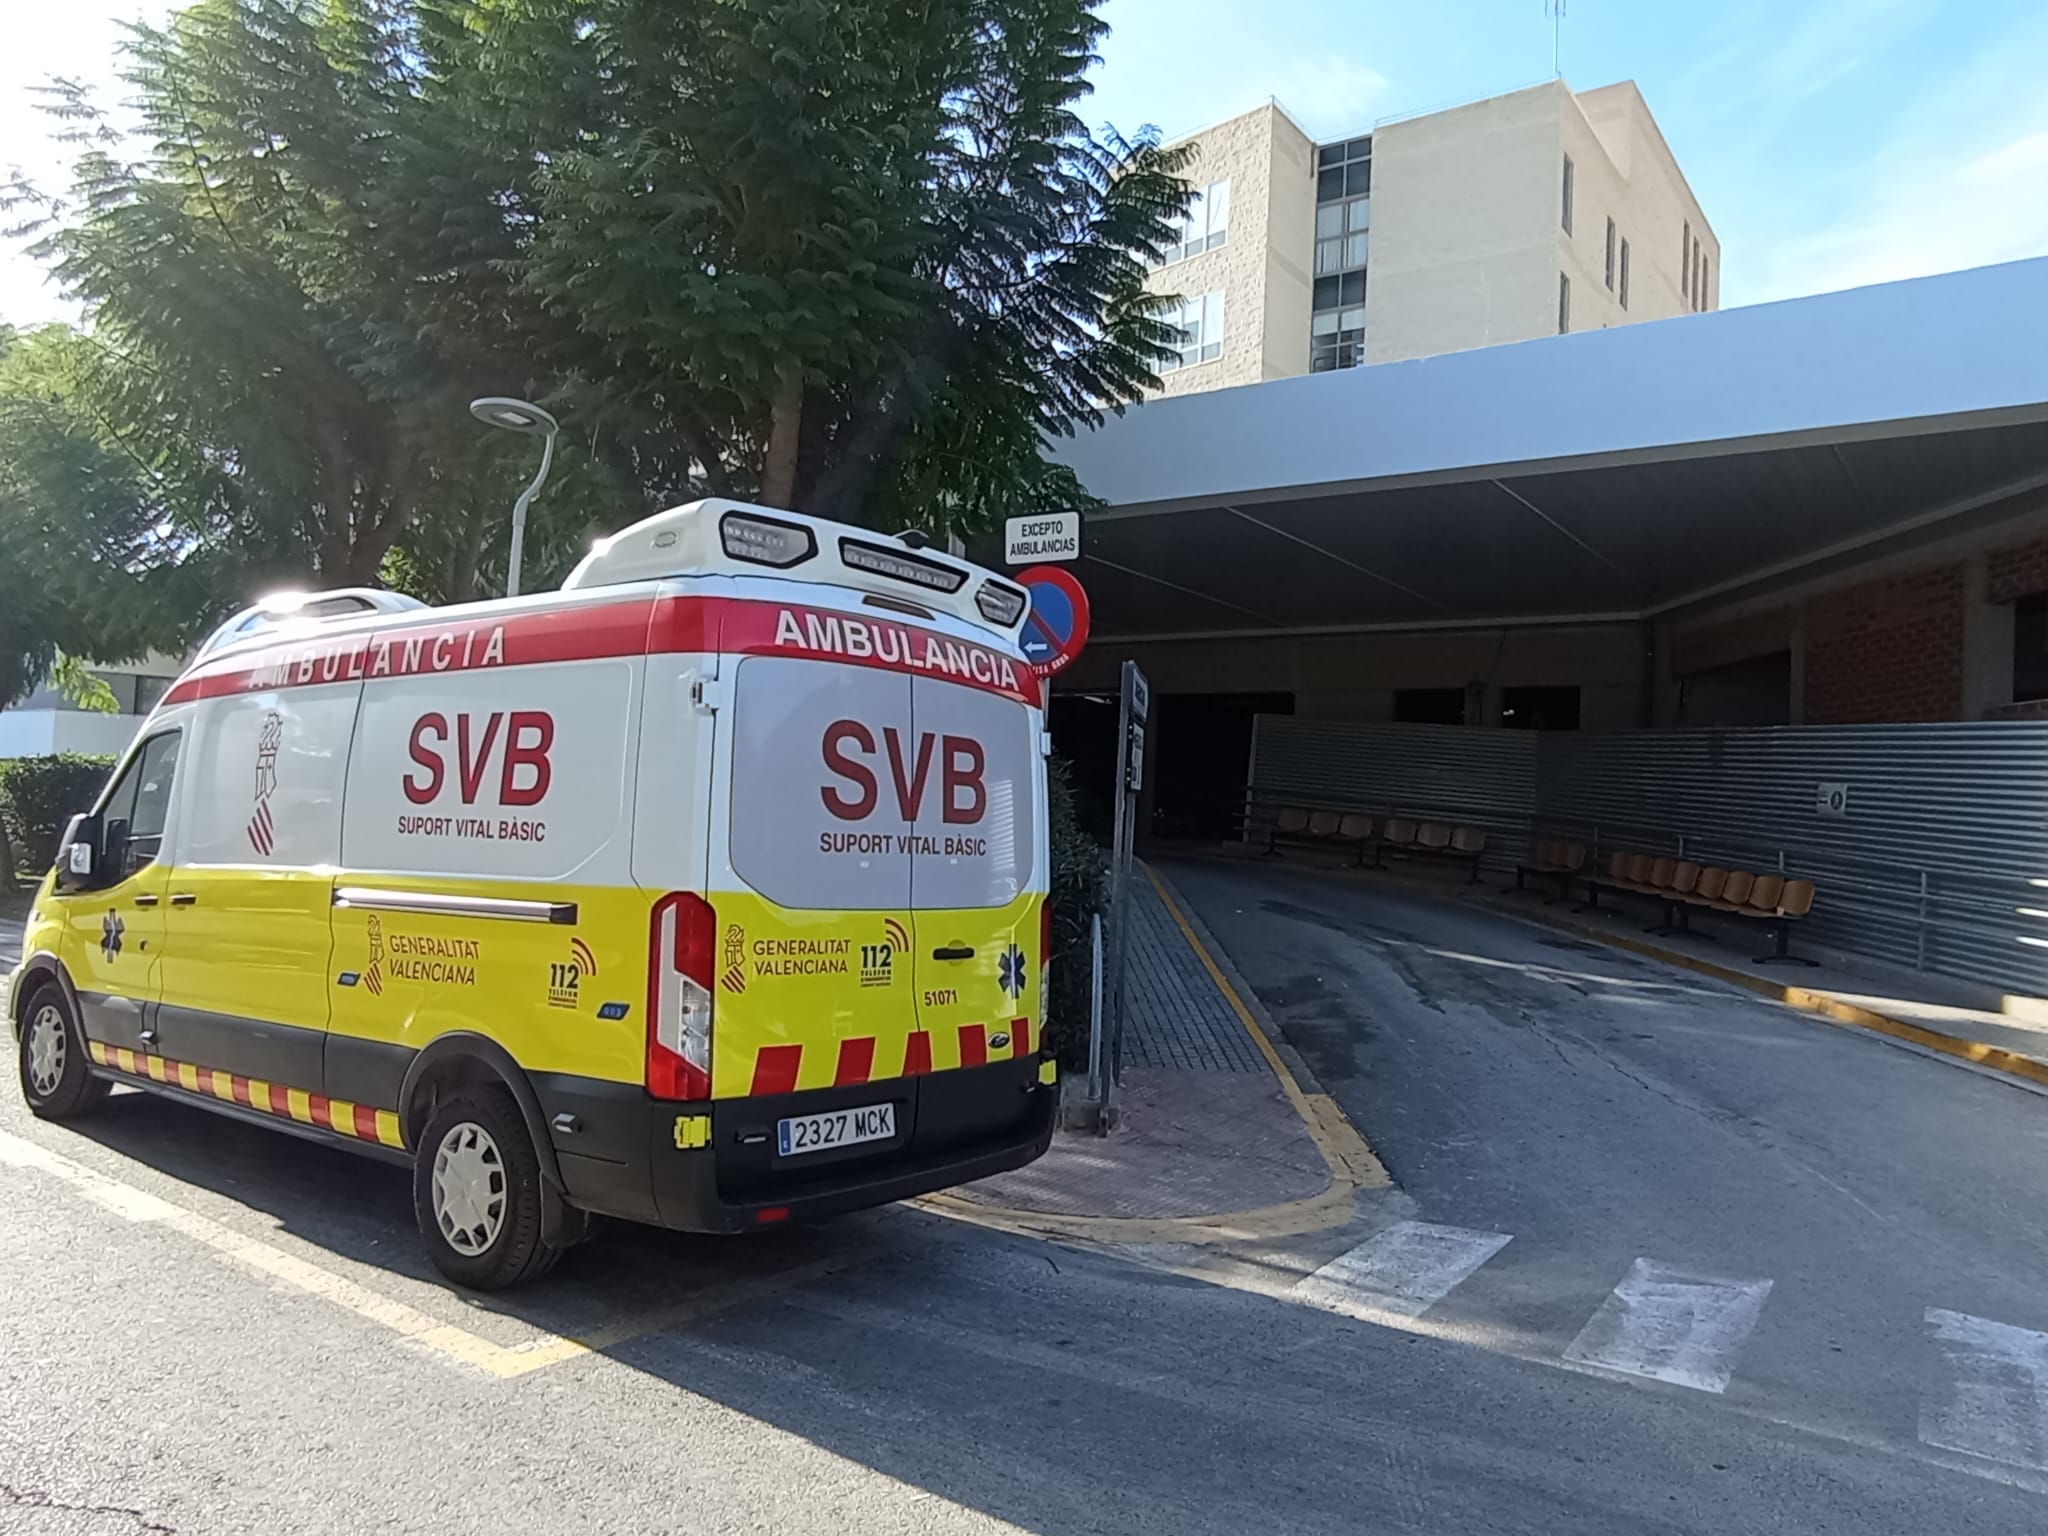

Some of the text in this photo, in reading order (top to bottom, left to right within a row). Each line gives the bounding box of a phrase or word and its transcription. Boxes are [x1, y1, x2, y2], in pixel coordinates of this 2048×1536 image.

[1021, 520, 1063, 537] EXCEPTO
[1010, 537, 1075, 556] AMBULANCIAS
[249, 626, 505, 689] AMBULANCIA
[774, 609, 1020, 692] AMBULANCIA
[403, 711, 554, 806] SVB
[820, 719, 987, 825] SVB
[398, 815, 546, 842] SUPORT VITAL BÀSIC
[820, 832, 987, 857] SUPORT VITAL BÀSIC
[389, 935, 479, 960] GENERALITAT
[752, 939, 851, 956] GENERALITAT
[861, 944, 892, 968] 112
[389, 958, 476, 986] VALENCIANA
[551, 963, 579, 989] 112
[754, 959, 848, 976] VALENCIANA
[924, 990, 958, 1007] 51071
[795, 1107, 891, 1149] 2327 MCK
